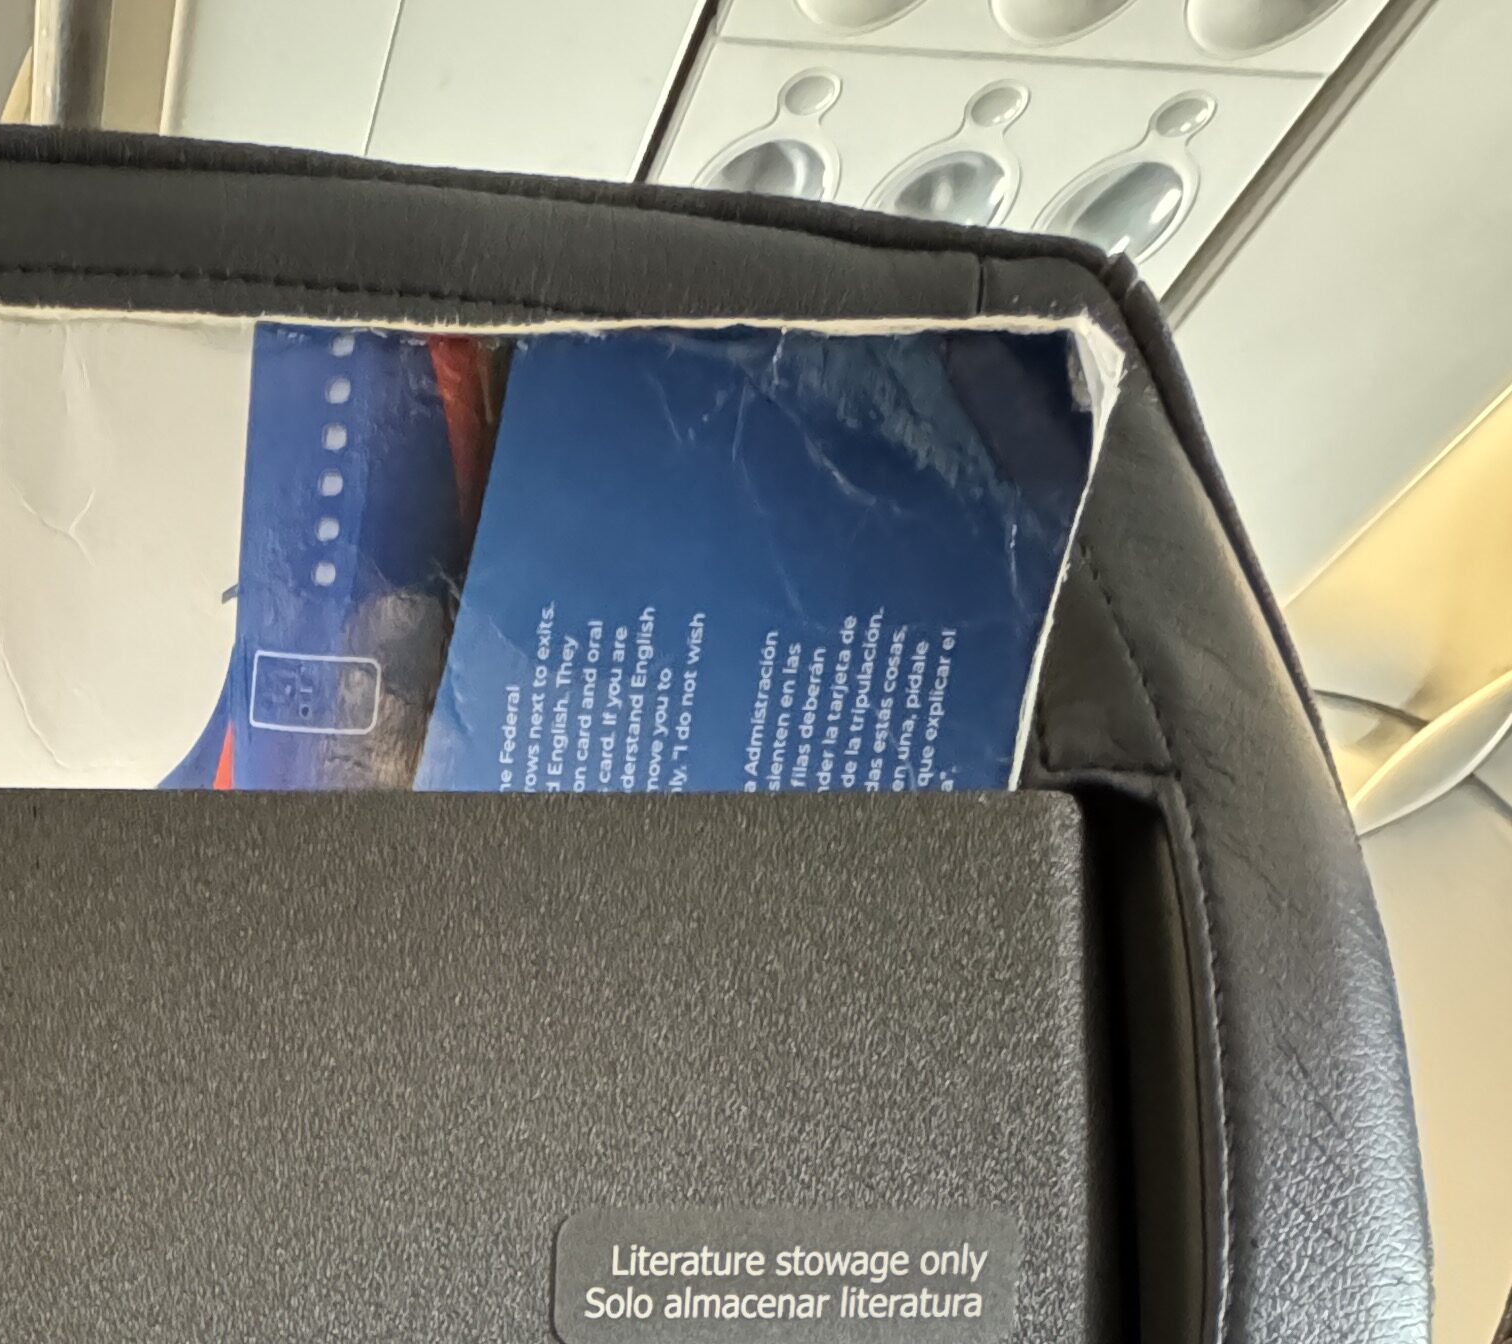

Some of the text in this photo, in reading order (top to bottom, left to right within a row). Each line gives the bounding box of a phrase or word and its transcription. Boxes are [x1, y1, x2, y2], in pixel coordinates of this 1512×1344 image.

[537, 600, 555, 660] exits.
[587, 620, 603, 662] oral
[613, 626, 628, 662] are
[687, 613, 706, 664] wish
[840, 615, 857, 645] de
[533, 665, 547, 688] to
[556, 636, 579, 688] They
[658, 667, 672, 690] to
[782, 642, 801, 674] las
[906, 640, 929, 709] pídale
[582, 668, 597, 709] and
[607, 668, 623, 710] you
[620, 606, 656, 792] derstand English
[682, 671, 698, 706] not
[780, 679, 796, 708] en
[827, 650, 852, 721] tarjeta
[841, 606, 885, 788] de la tripulación.
[499, 685, 520, 764] Federal
[529, 692, 545, 739] next
[602, 712, 617, 726] If
[653, 695, 669, 737] you
[676, 712, 691, 740] do
[791, 647, 827, 788] filas deberán
[873, 697, 894, 753] estas
[917, 627, 957, 787] que explicar el
[548, 692, 569, 775] English.
[577, 715, 592, 761] card
[822, 725, 838, 745] la
[598, 732, 616, 783] card.
[611, 1242, 988, 1283] Literature stowage only
[584, 1286, 983, 1320] Solo almacenar literatura
